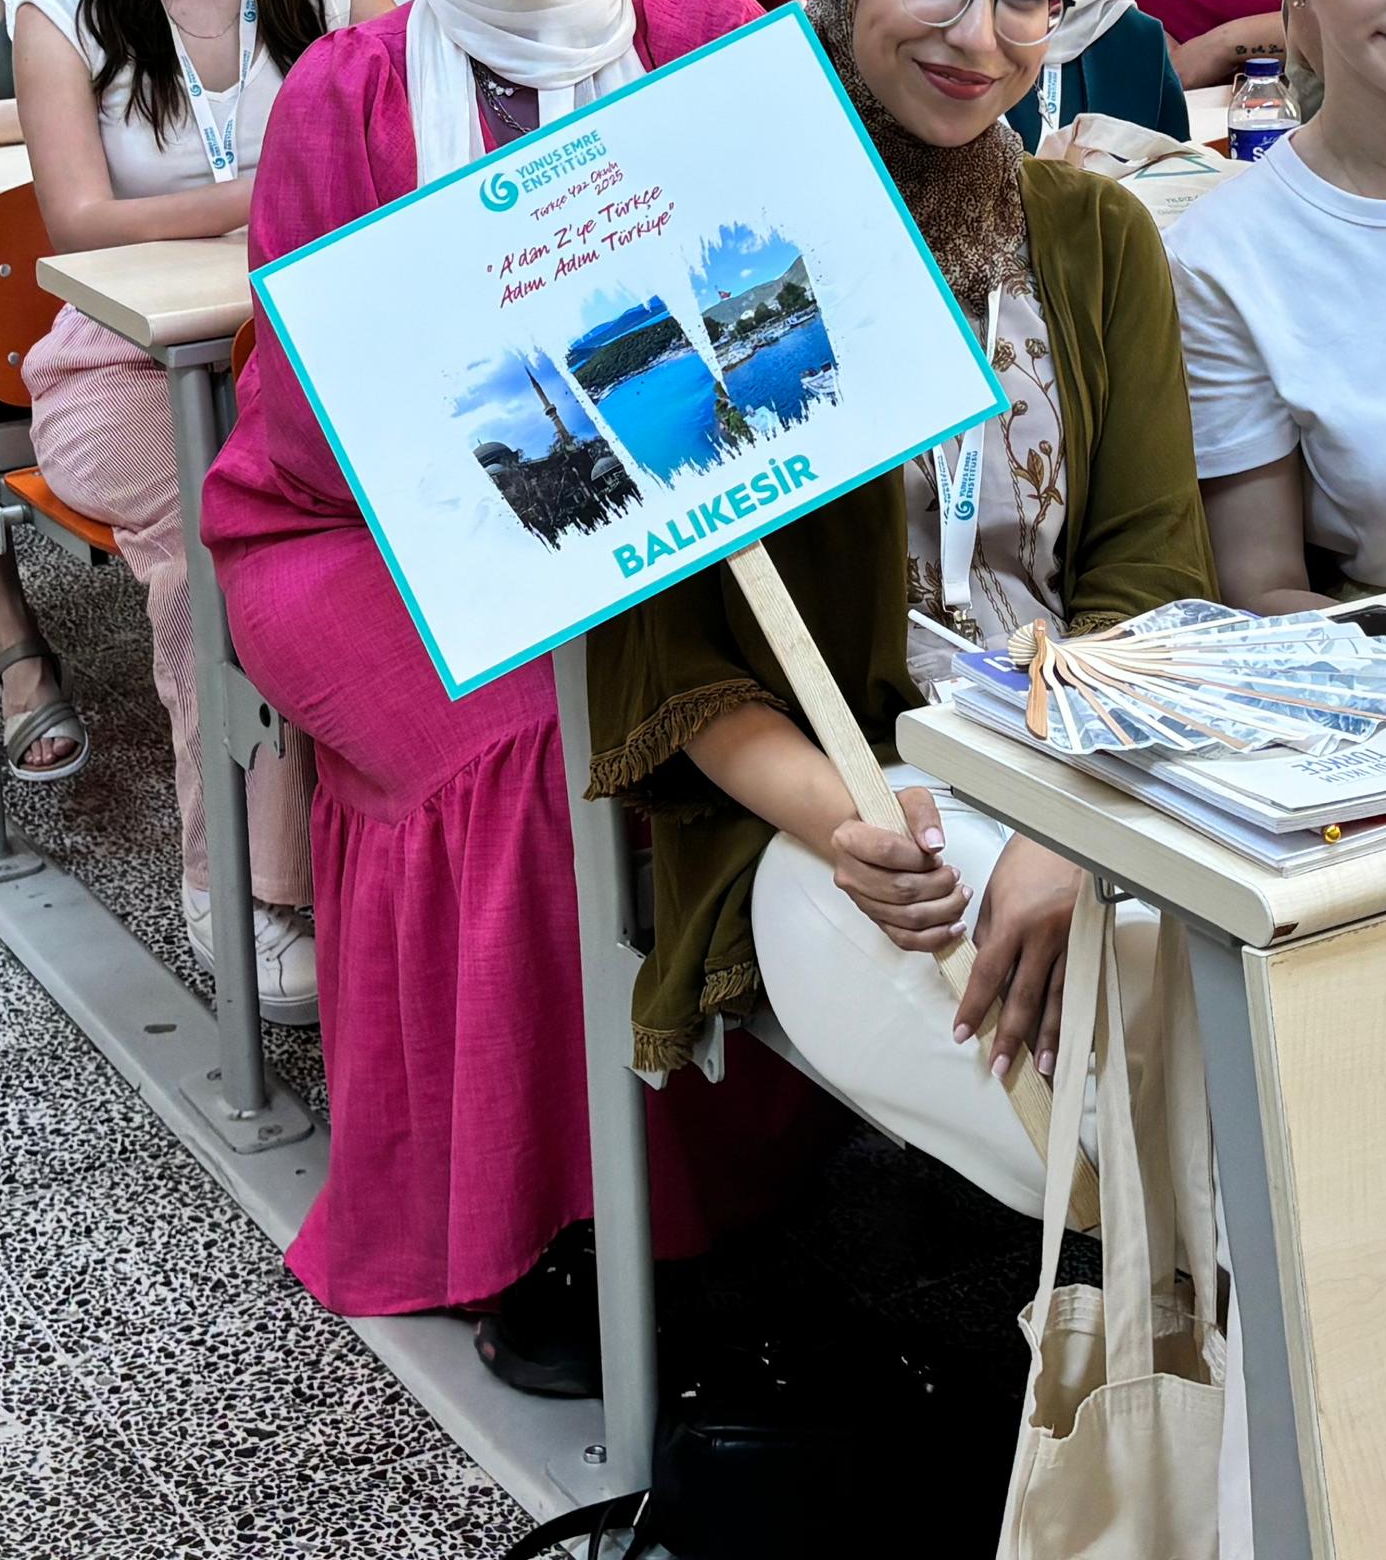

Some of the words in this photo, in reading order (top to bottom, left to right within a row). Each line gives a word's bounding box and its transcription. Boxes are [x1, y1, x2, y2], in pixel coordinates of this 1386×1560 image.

[516, 149, 562, 179] YUNUS
[562, 130, 601, 155] EMRE
[521, 145, 607, 193] ENSTİTÜSÜ
[594, 171, 623, 195] 2025
[530, 195, 568, 221] Türkçe
[554, 219, 597, 249] Z'ye
[598, 185, 662, 222] Türkçe
[500, 276, 546, 308] Adım
[554, 249, 600, 281] Adım
[612, 452, 819, 580] BALIKESİR
